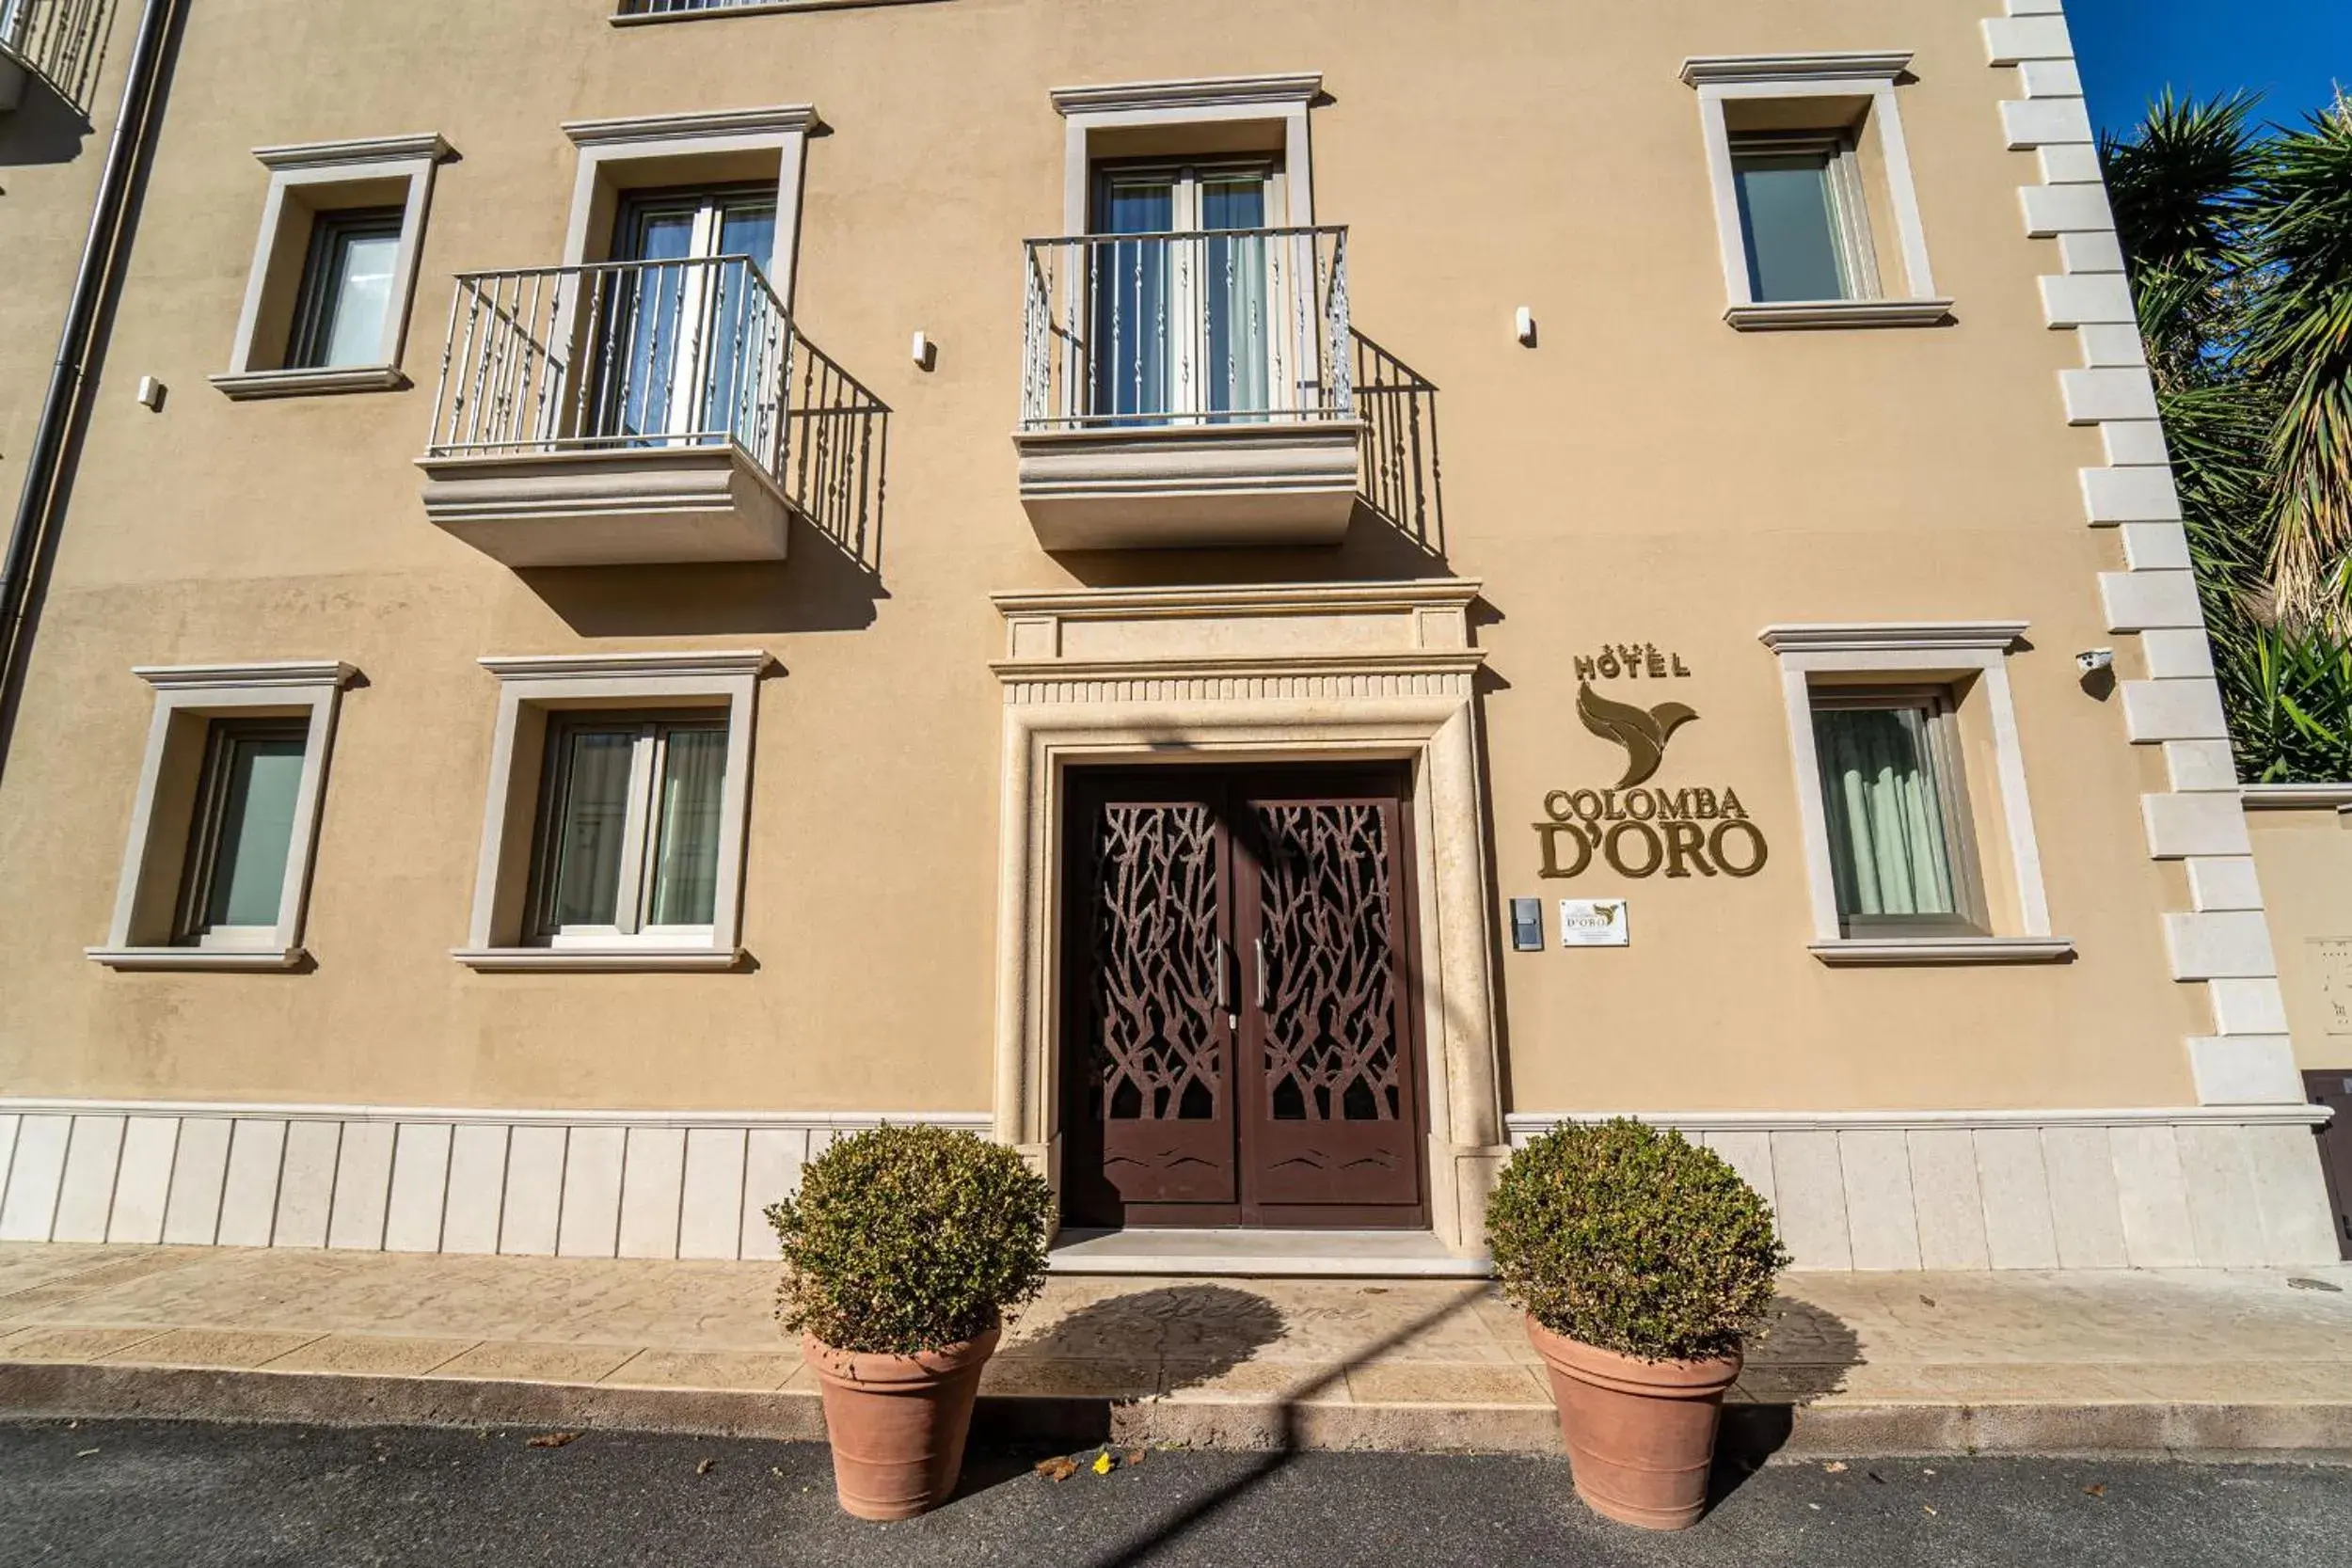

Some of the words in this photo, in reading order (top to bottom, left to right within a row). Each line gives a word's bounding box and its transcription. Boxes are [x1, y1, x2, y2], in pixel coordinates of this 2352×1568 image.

[1574, 653, 1691, 679] HOTEL
[1544, 787, 1749, 820] COLOMBA
[1532, 819, 1768, 879] D'ORO
